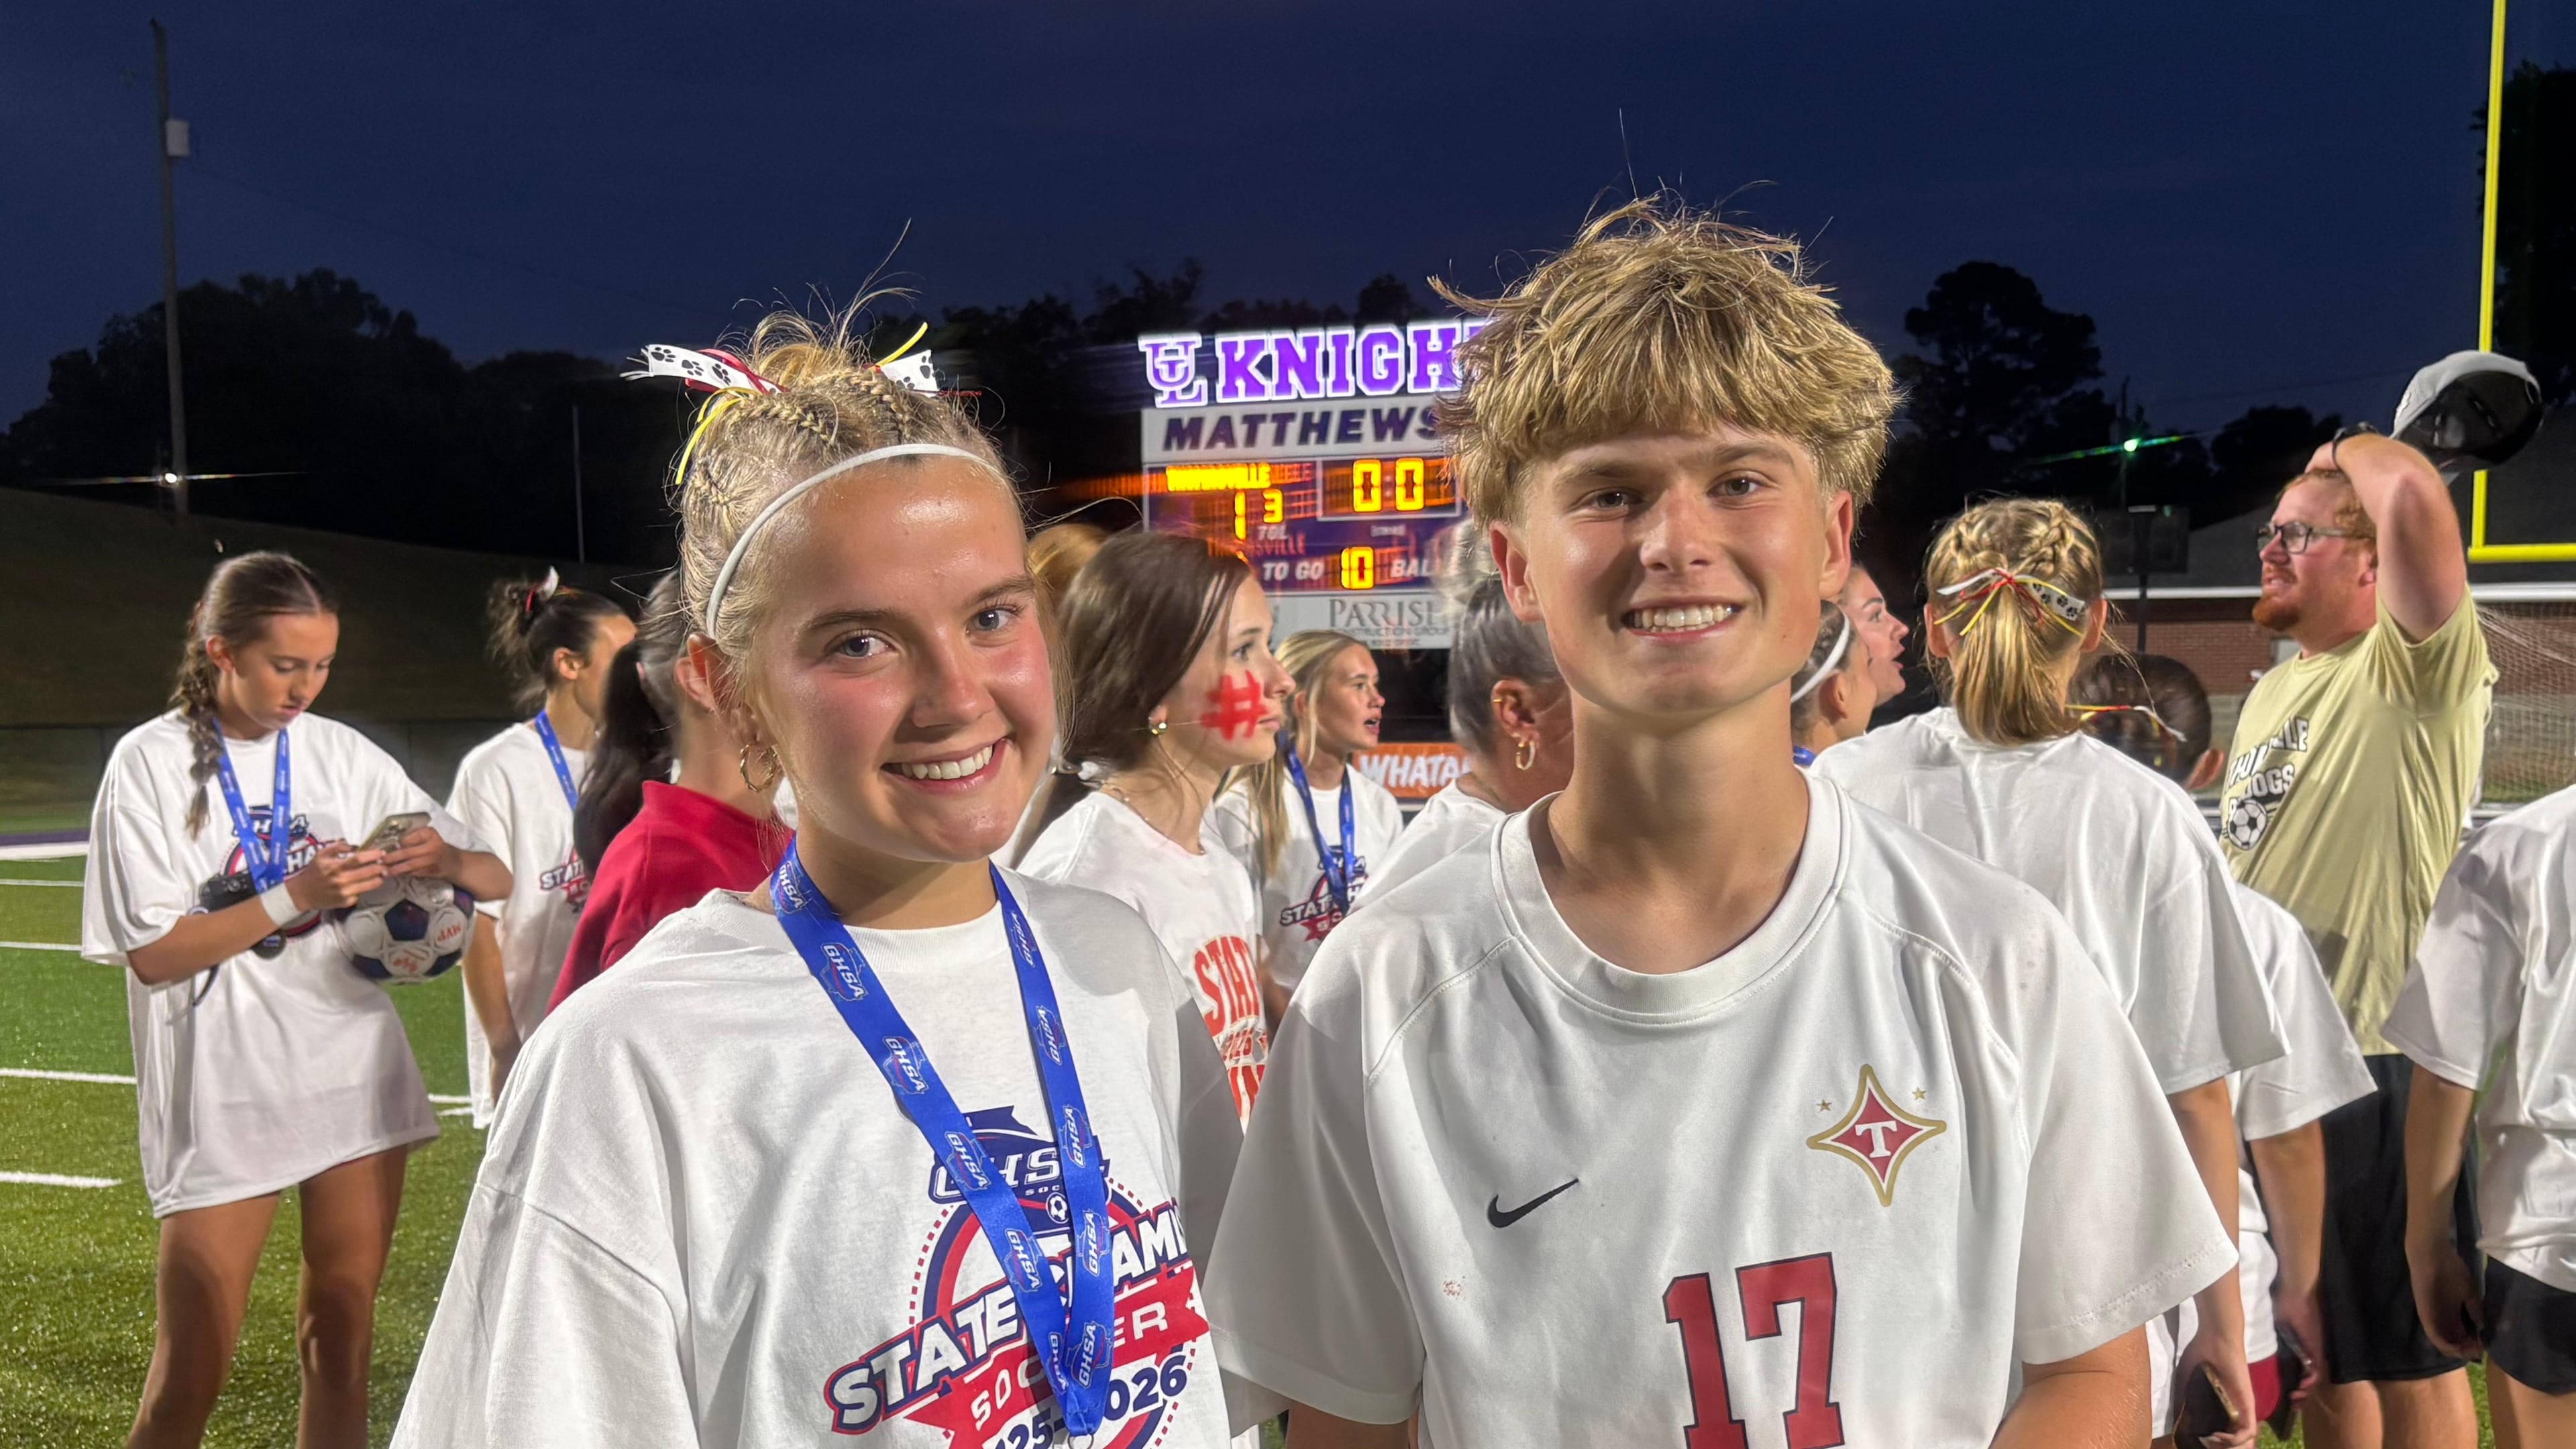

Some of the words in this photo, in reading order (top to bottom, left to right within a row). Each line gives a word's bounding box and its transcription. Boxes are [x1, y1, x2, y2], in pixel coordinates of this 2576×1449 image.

[1216, 321, 1500, 403] KNIGH
[1263, 561, 1289, 581] TO
[1295, 561, 1324, 580] GO
[1390, 558, 1432, 578] BAL
[541, 861, 584, 889] STAT
[1281, 894, 1333, 926] STAT
[823, 945, 867, 1000] GHSA
[1194, 936, 1260, 1038] STAT
[1036, 1007, 1062, 1065] GHSA
[885, 1038, 927, 1093] GHSA
[947, 1133, 989, 1187] GHSA
[1063, 1106, 1085, 1167] GHSA
[1855, 1121, 1898, 1159] T
[1025, 1185, 1062, 1196] SOC
[1007, 1230, 1042, 1289] GHSA
[1083, 1210, 1099, 1276] GHSA
[834, 1285, 1019, 1425] STATE
[1077, 1323, 1096, 1389] GHSA
[1663, 1252, 1845, 1449] 17
